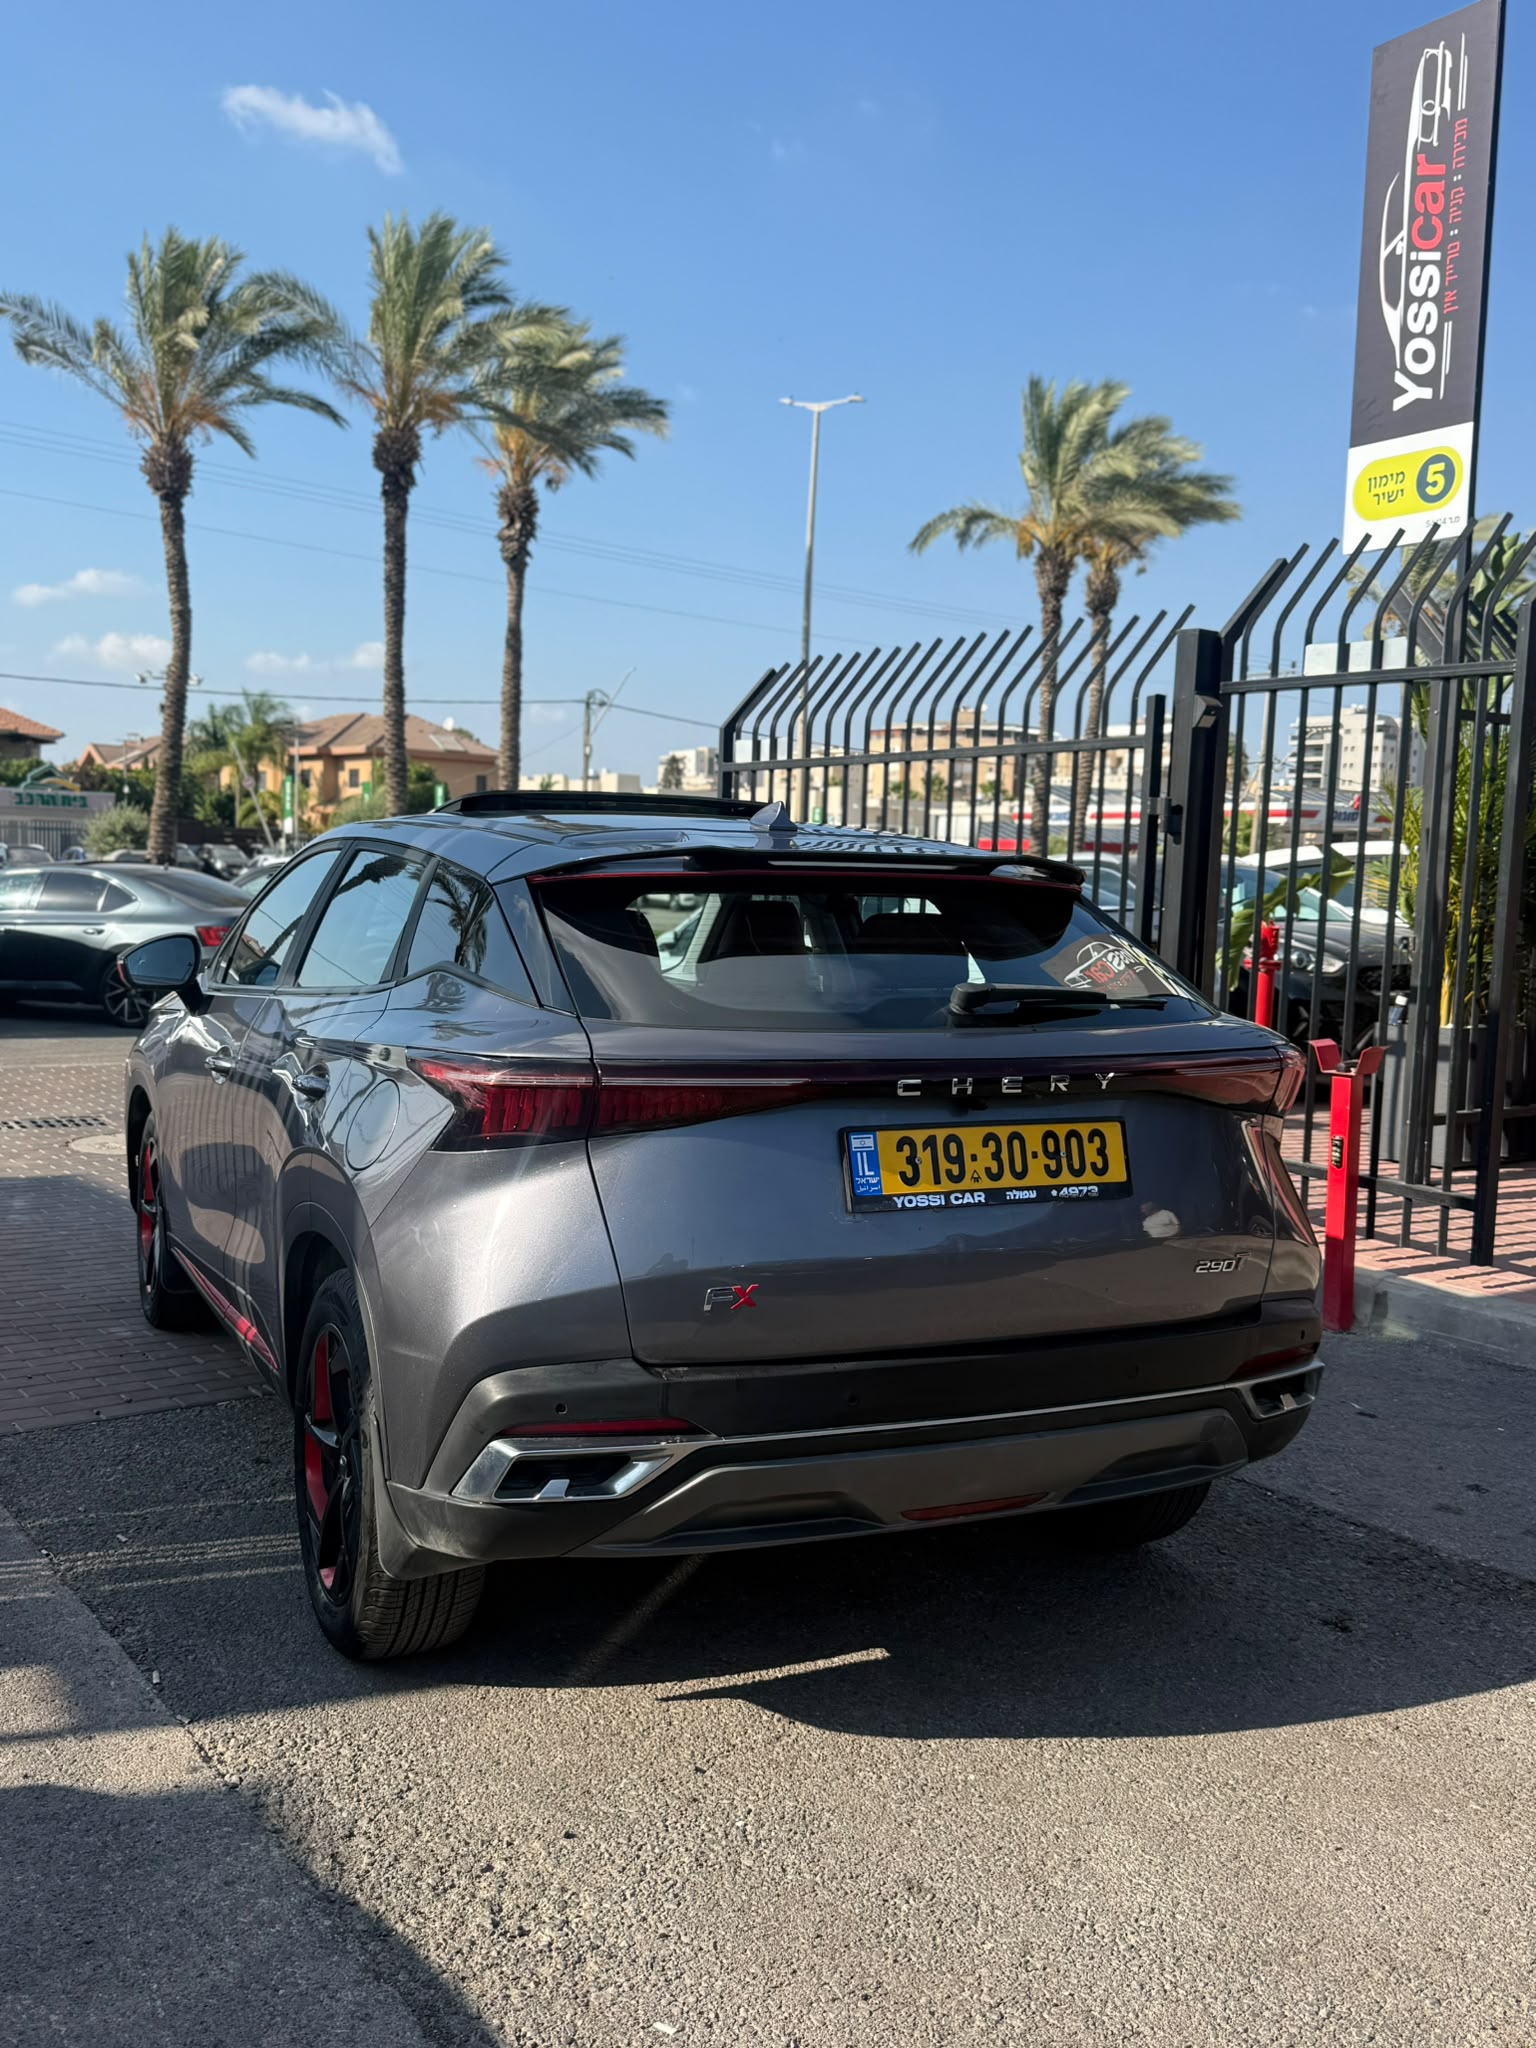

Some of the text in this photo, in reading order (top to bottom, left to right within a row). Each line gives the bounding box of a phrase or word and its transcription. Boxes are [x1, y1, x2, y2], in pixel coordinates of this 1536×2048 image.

[1443, 117, 1468, 315] מכירה קניה טרייד אין
[1367, 470, 1406, 493] מימון
[1425, 462, 1446, 496] 5
[1373, 488, 1405, 505] ישיר
[15, 792, 58, 807] הרכב
[897, 1072, 1115, 1096] CHERY
[857, 1151, 875, 1176] IL
[855, 1176, 880, 1185] ישראל
[892, 1191, 985, 1208] YOSSI CAR
[1006, 1189, 1037, 1200] עפולה
[1194, 1252, 1251, 1272] 290T
[704, 1284, 759, 1311] FX
